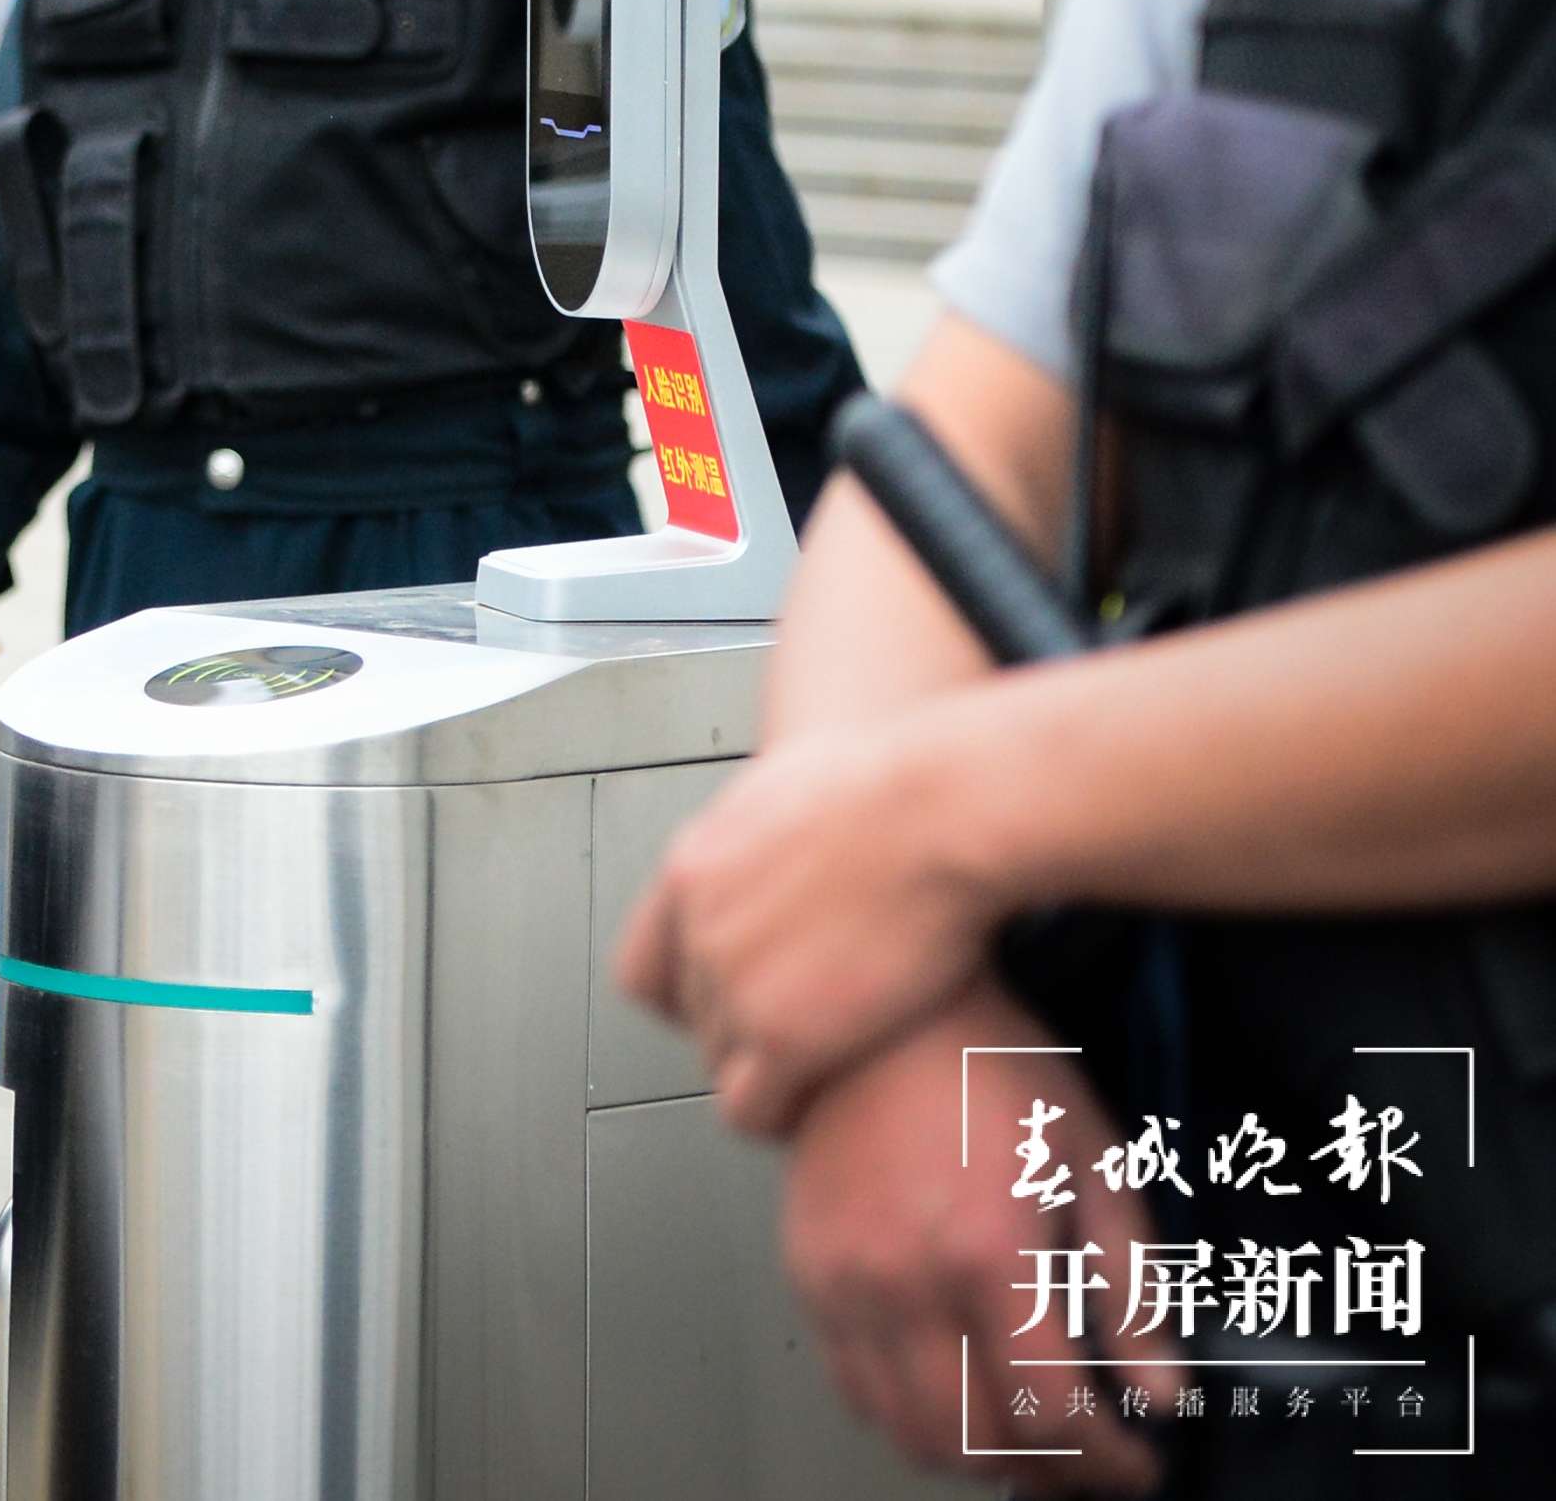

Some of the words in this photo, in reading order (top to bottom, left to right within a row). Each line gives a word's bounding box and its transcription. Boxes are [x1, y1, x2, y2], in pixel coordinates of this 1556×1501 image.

[643, 364, 706, 417] 人脸识别
[659, 443, 727, 498] 红外测温
